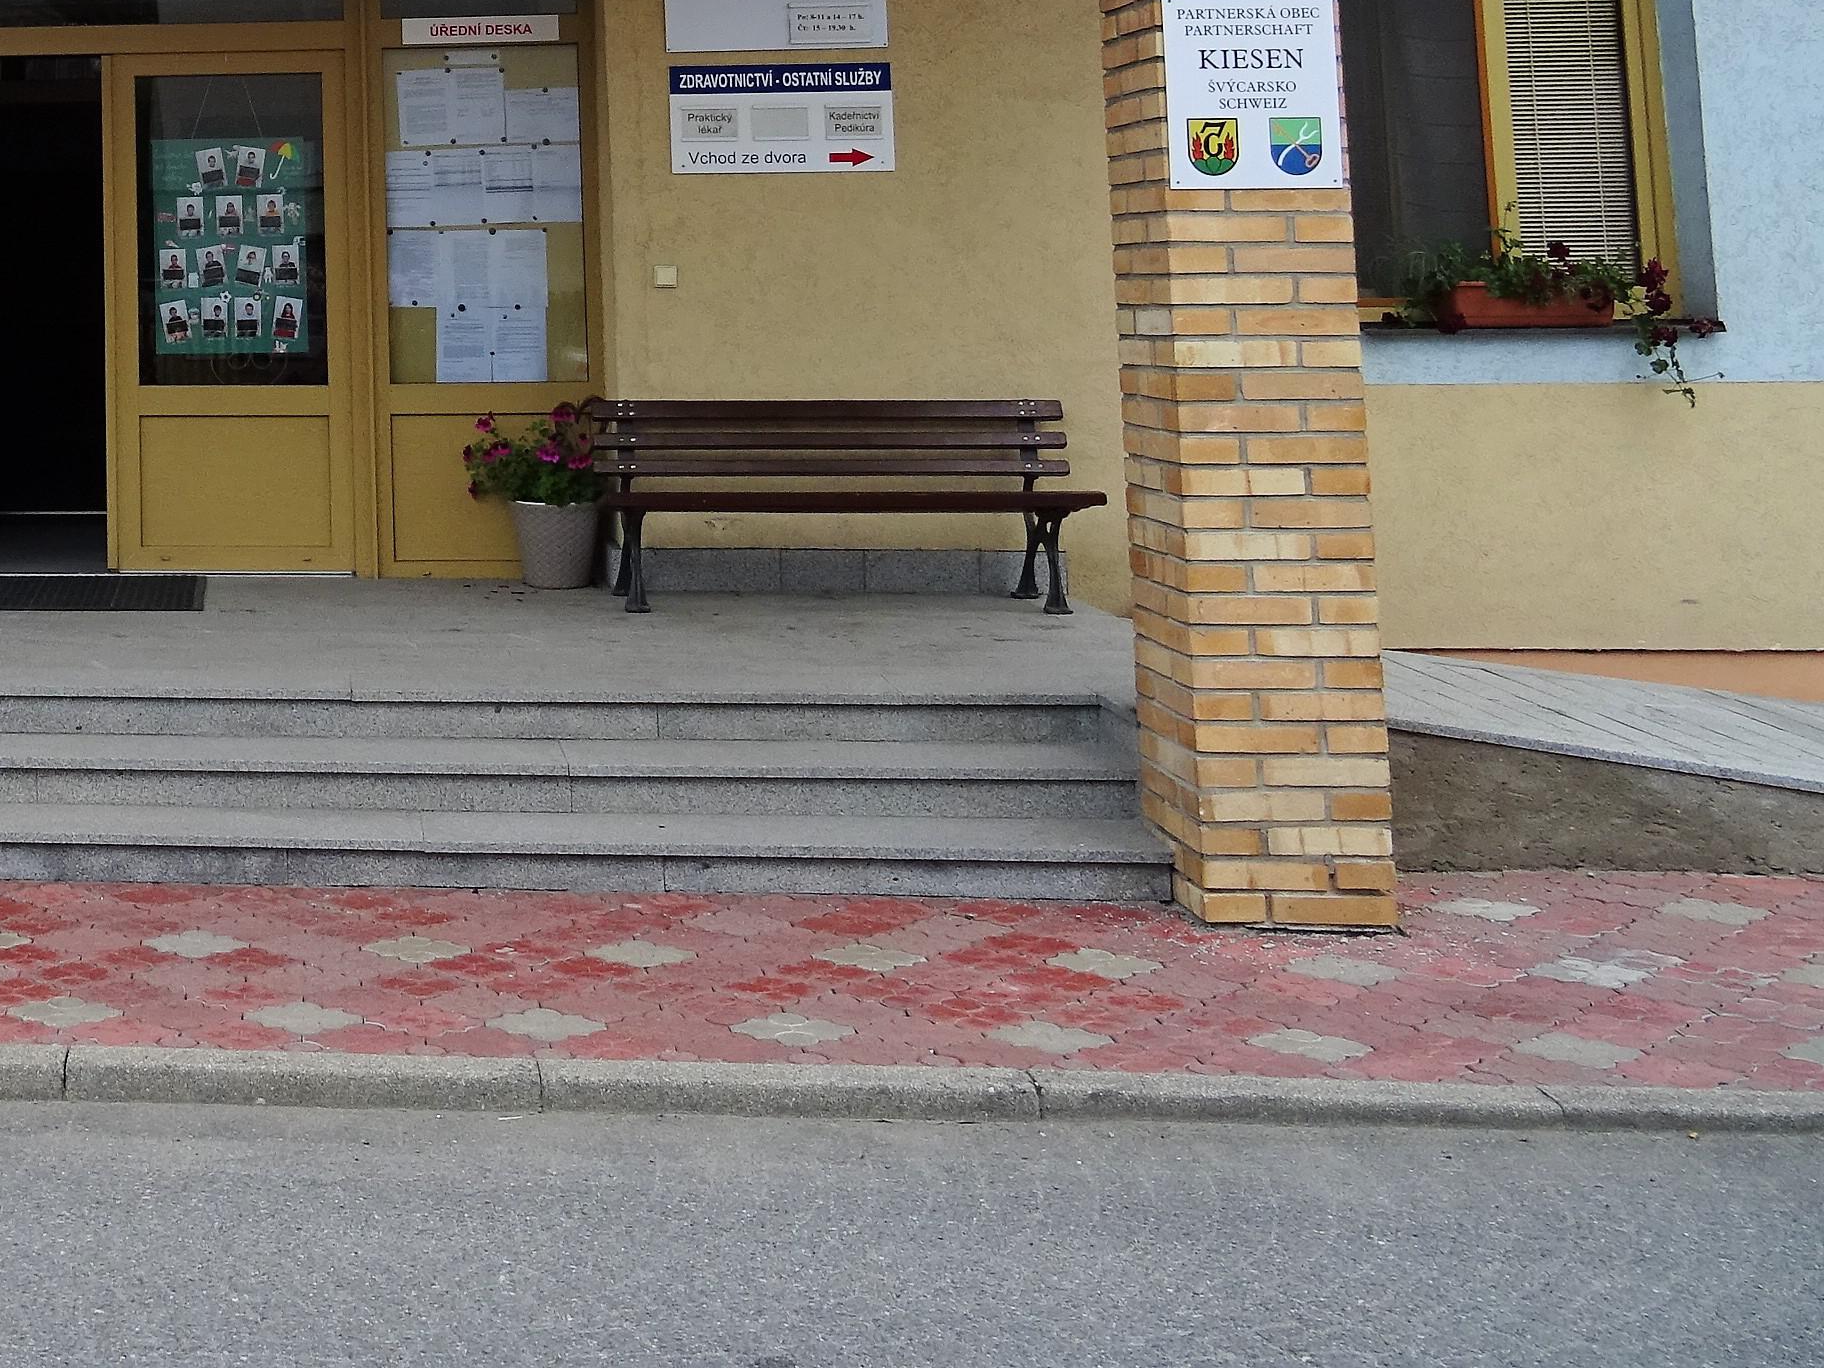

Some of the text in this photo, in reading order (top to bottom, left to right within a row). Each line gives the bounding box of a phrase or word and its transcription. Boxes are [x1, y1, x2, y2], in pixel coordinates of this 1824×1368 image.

[1177, 5, 1320, 20] PARTNERSKÁ OBEC
[430, 23, 533, 37] ÚŘEDNÍ DESKA
[1185, 23, 1314, 36] PARTNERSCHAFT
[1198, 48, 1304, 70] KIESEN
[679, 70, 773, 89] ZDRAVOTNICTVÍ
[782, 69, 832, 87] OSTATNÍ
[835, 68, 882, 86] SLUŽBY
[1208, 79, 1297, 93] ŠVÝCARSKO
[1219, 97, 1288, 109] SCHWEIZ
[687, 113, 733, 123] Praktický
[698, 125, 723, 134] lékař
[834, 123, 875, 133] Pedikúra
[689, 151, 806, 165] Vchod ze dvora
